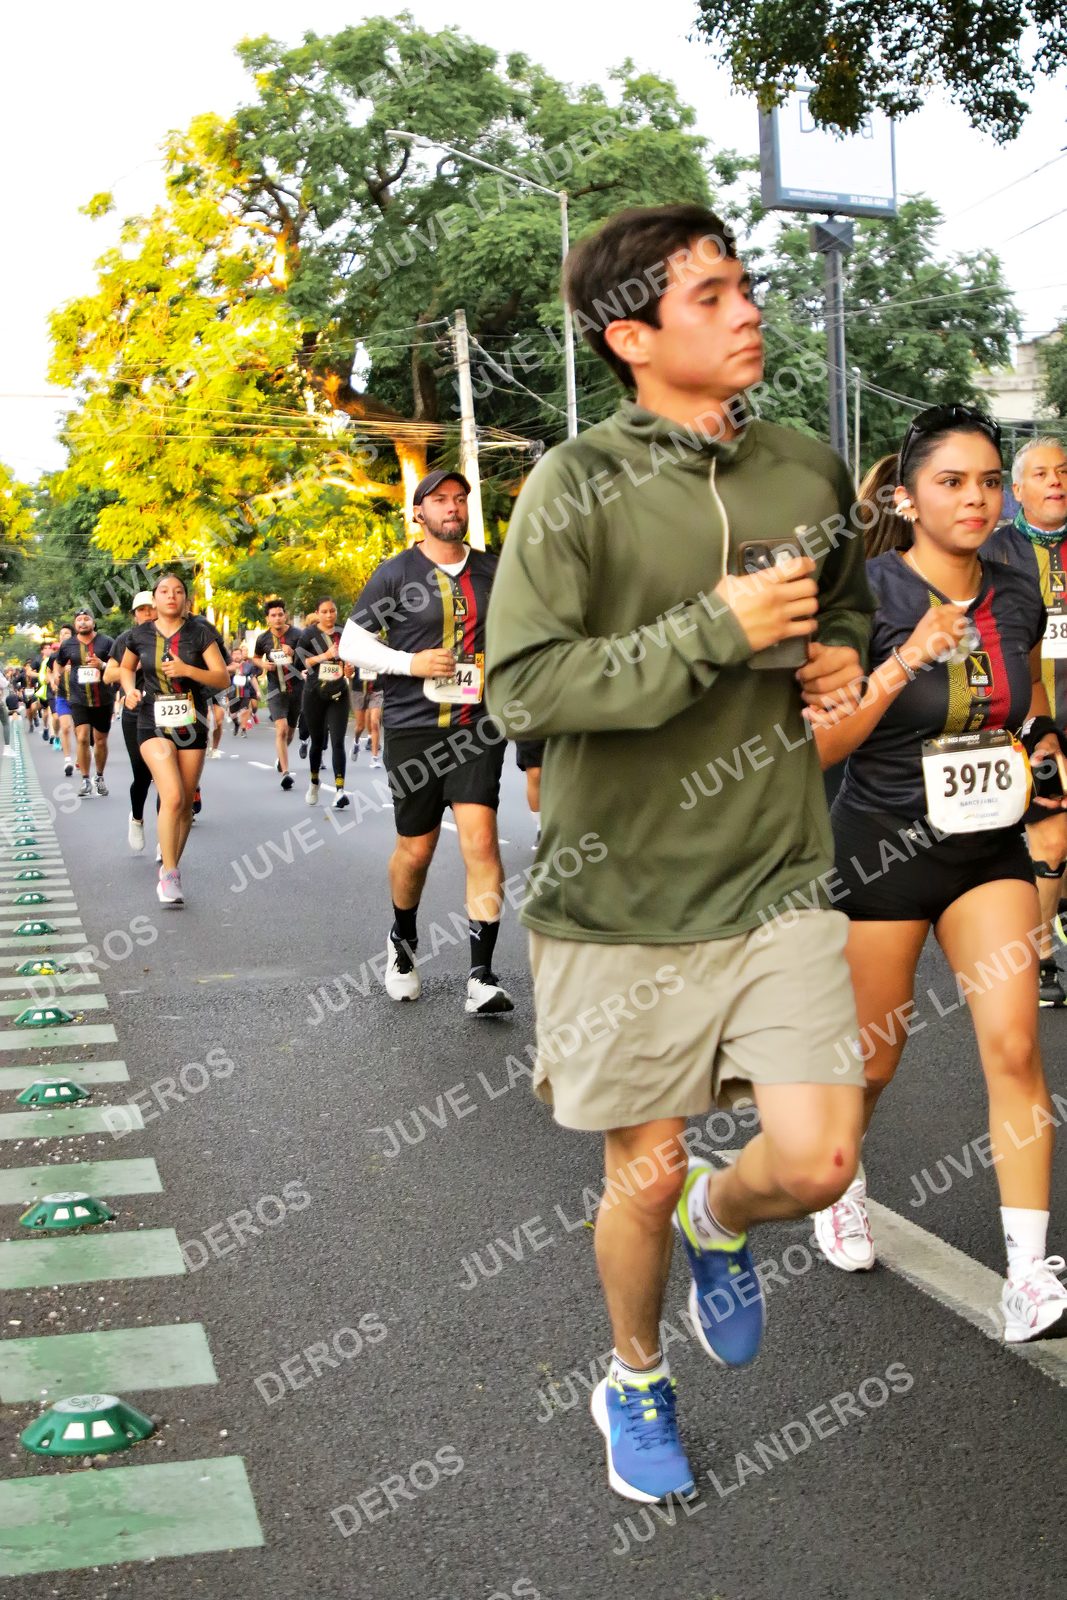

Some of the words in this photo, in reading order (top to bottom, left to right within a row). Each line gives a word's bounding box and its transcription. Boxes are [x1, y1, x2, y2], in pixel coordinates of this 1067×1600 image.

[1042, 622, 1067, 640] 38
[456, 670, 473, 686] 44
[160, 704, 188, 716] 3239
[943, 759, 1012, 797] 3978
